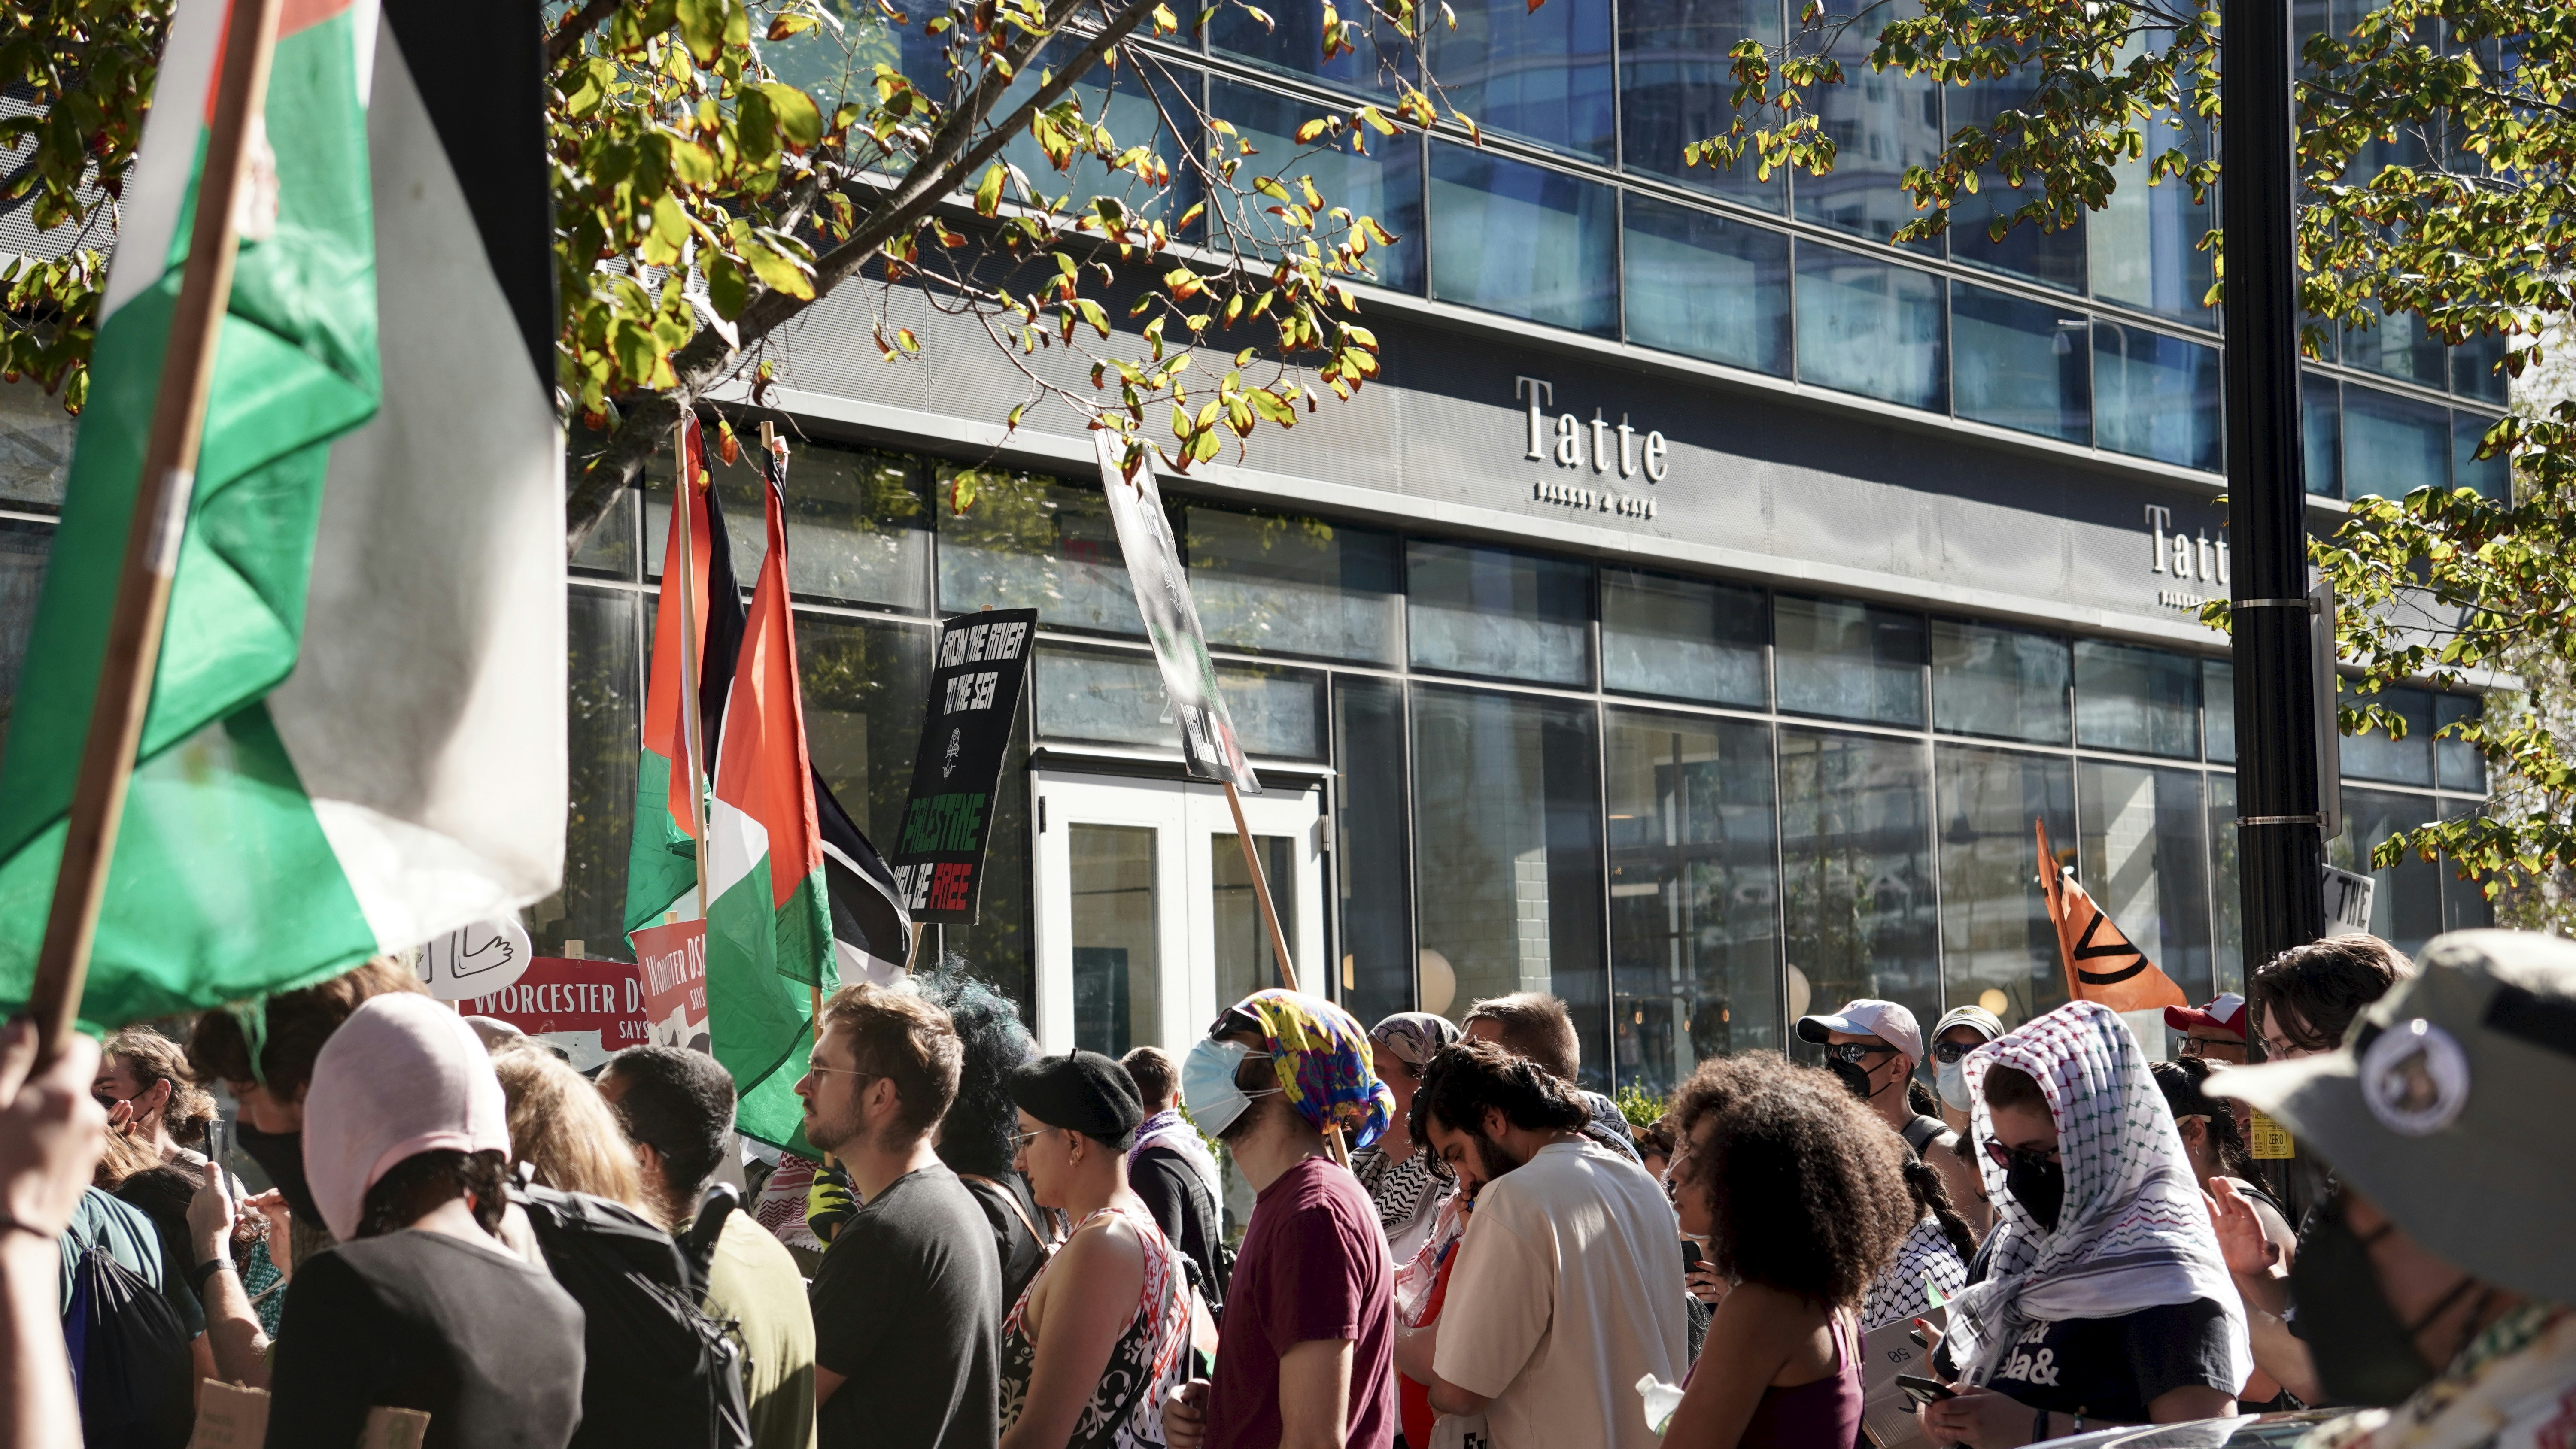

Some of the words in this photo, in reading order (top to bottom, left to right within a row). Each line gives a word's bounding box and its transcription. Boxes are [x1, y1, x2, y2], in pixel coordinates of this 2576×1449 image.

[1516, 375, 1668, 481] Tatte
[1537, 481, 1597, 506] BAKERY
[1603, 493, 1613, 509] &
[1619, 496, 1658, 516] CAFÉ
[2145, 504, 2228, 584] Tatt
[939, 627, 969, 668] FROM
[966, 624, 989, 664] THE
[984, 622, 1027, 661] RIVER
[943, 676, 958, 715] TO
[953, 673, 975, 713] THE
[969, 671, 999, 710] SEA
[900, 793, 986, 854] PALESTINE
[911, 862, 934, 910] BE
[929, 862, 972, 911] FREE
[2337, 876, 2371, 928] THE
[474, 984, 616, 1014] WORCESTER
[690, 986, 705, 1011] SAYS
[619, 1020, 649, 1039] SAYS
[2269, 1134, 2284, 1145] ZERO
